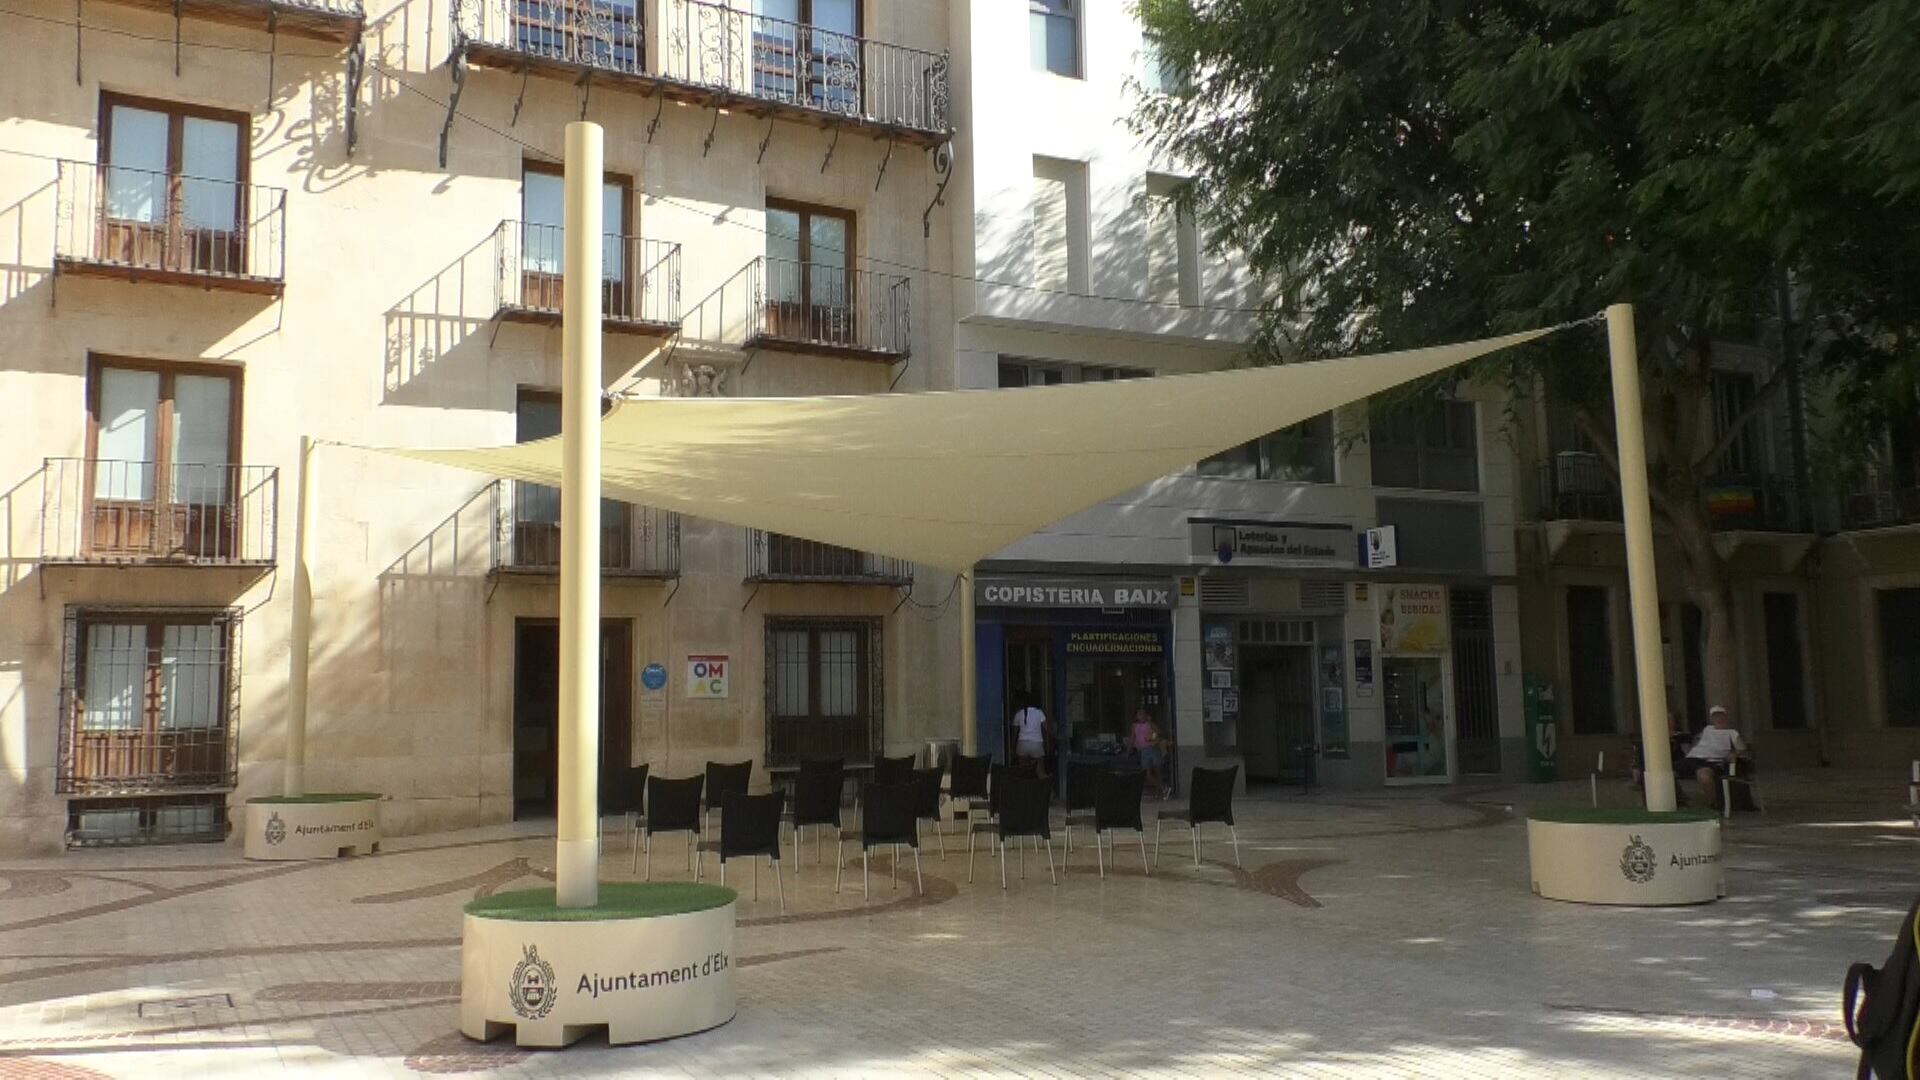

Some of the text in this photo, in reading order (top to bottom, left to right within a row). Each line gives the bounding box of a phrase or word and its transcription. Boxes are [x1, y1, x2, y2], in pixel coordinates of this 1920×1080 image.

[1286, 544, 1302, 555] del
[1303, 545, 1336, 556] Estado
[984, 585, 1169, 606] COPISTERIA BAIX
[1071, 632, 1159, 642] PLASTIFICACIONES
[1066, 642, 1163, 653] ENCUADERNACIONES
[295, 822, 355, 836] Ajuntament
[577, 950, 729, 998] Ajuntament d'Elx
